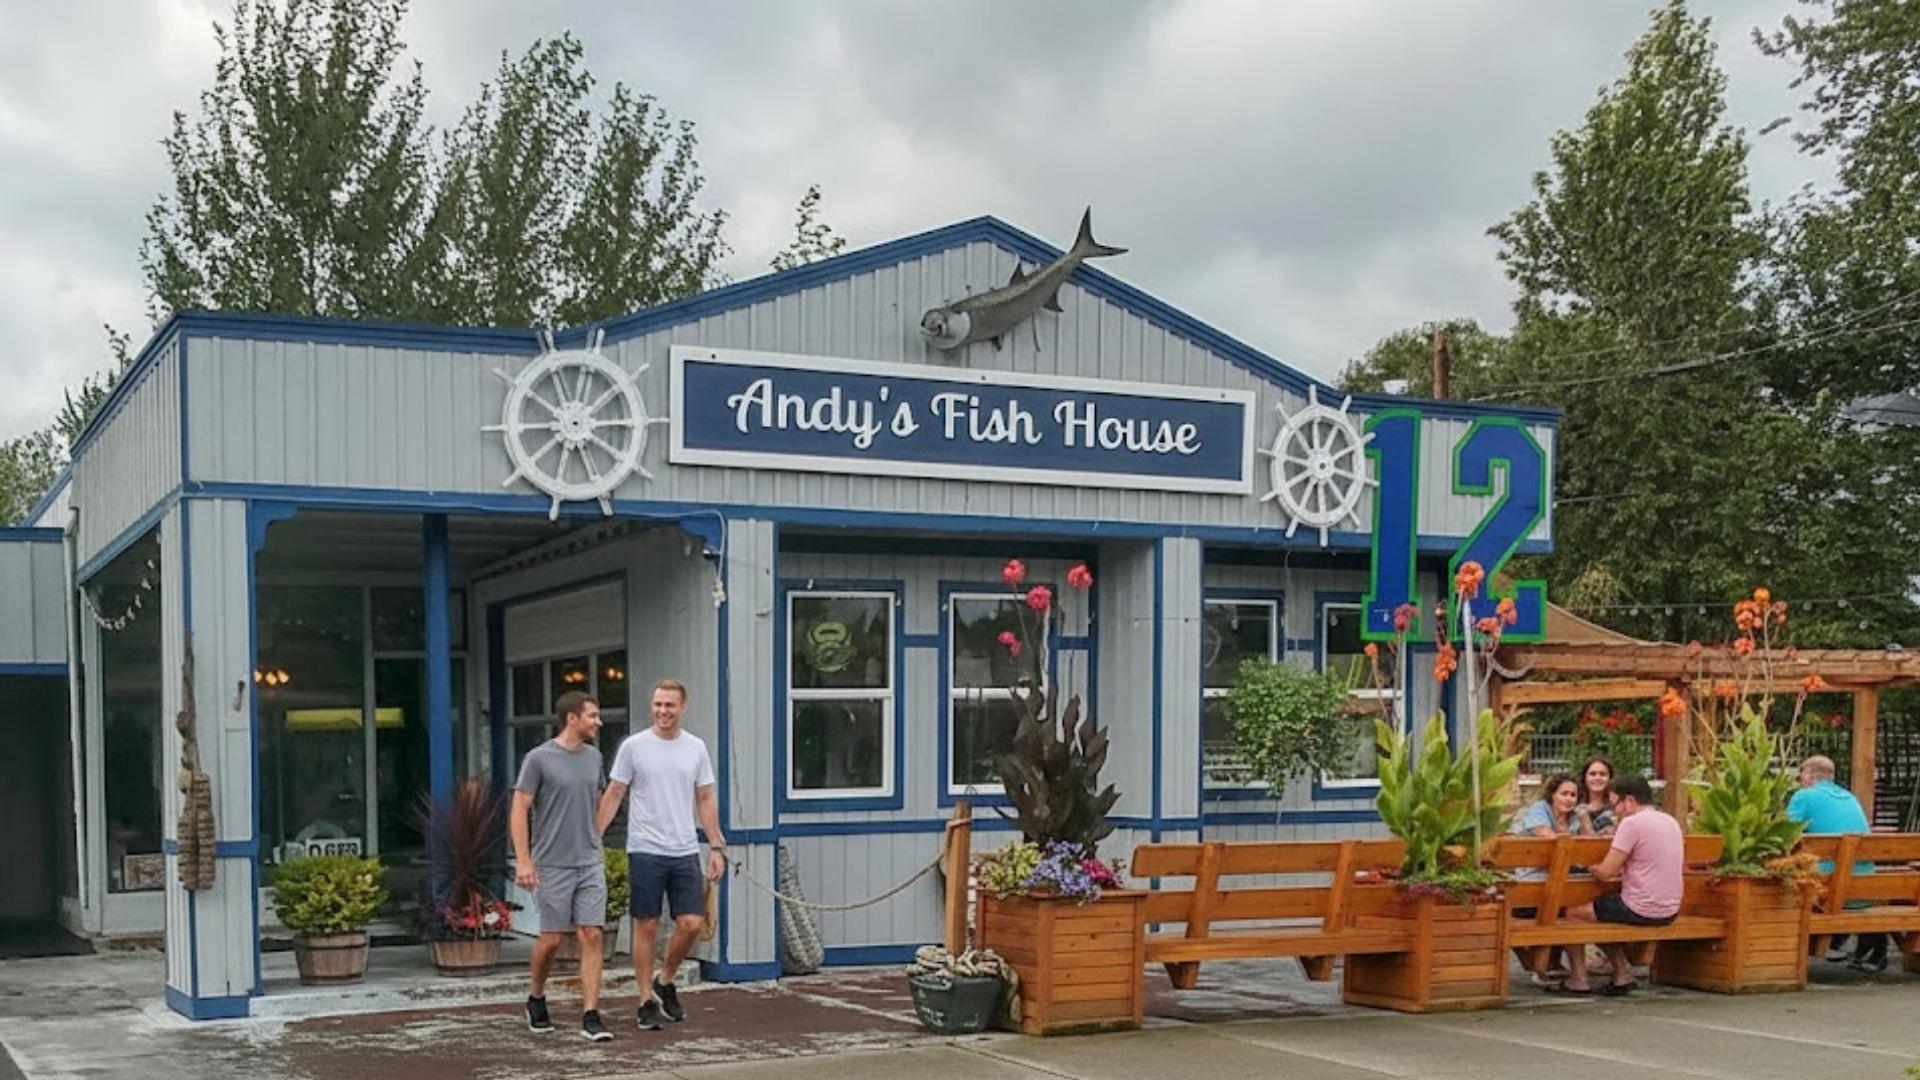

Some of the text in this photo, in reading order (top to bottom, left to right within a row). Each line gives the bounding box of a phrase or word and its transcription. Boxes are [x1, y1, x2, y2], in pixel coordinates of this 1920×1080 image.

[727, 378, 1201, 454] Andy's Fish House
[1361, 407, 1547, 642] 12
